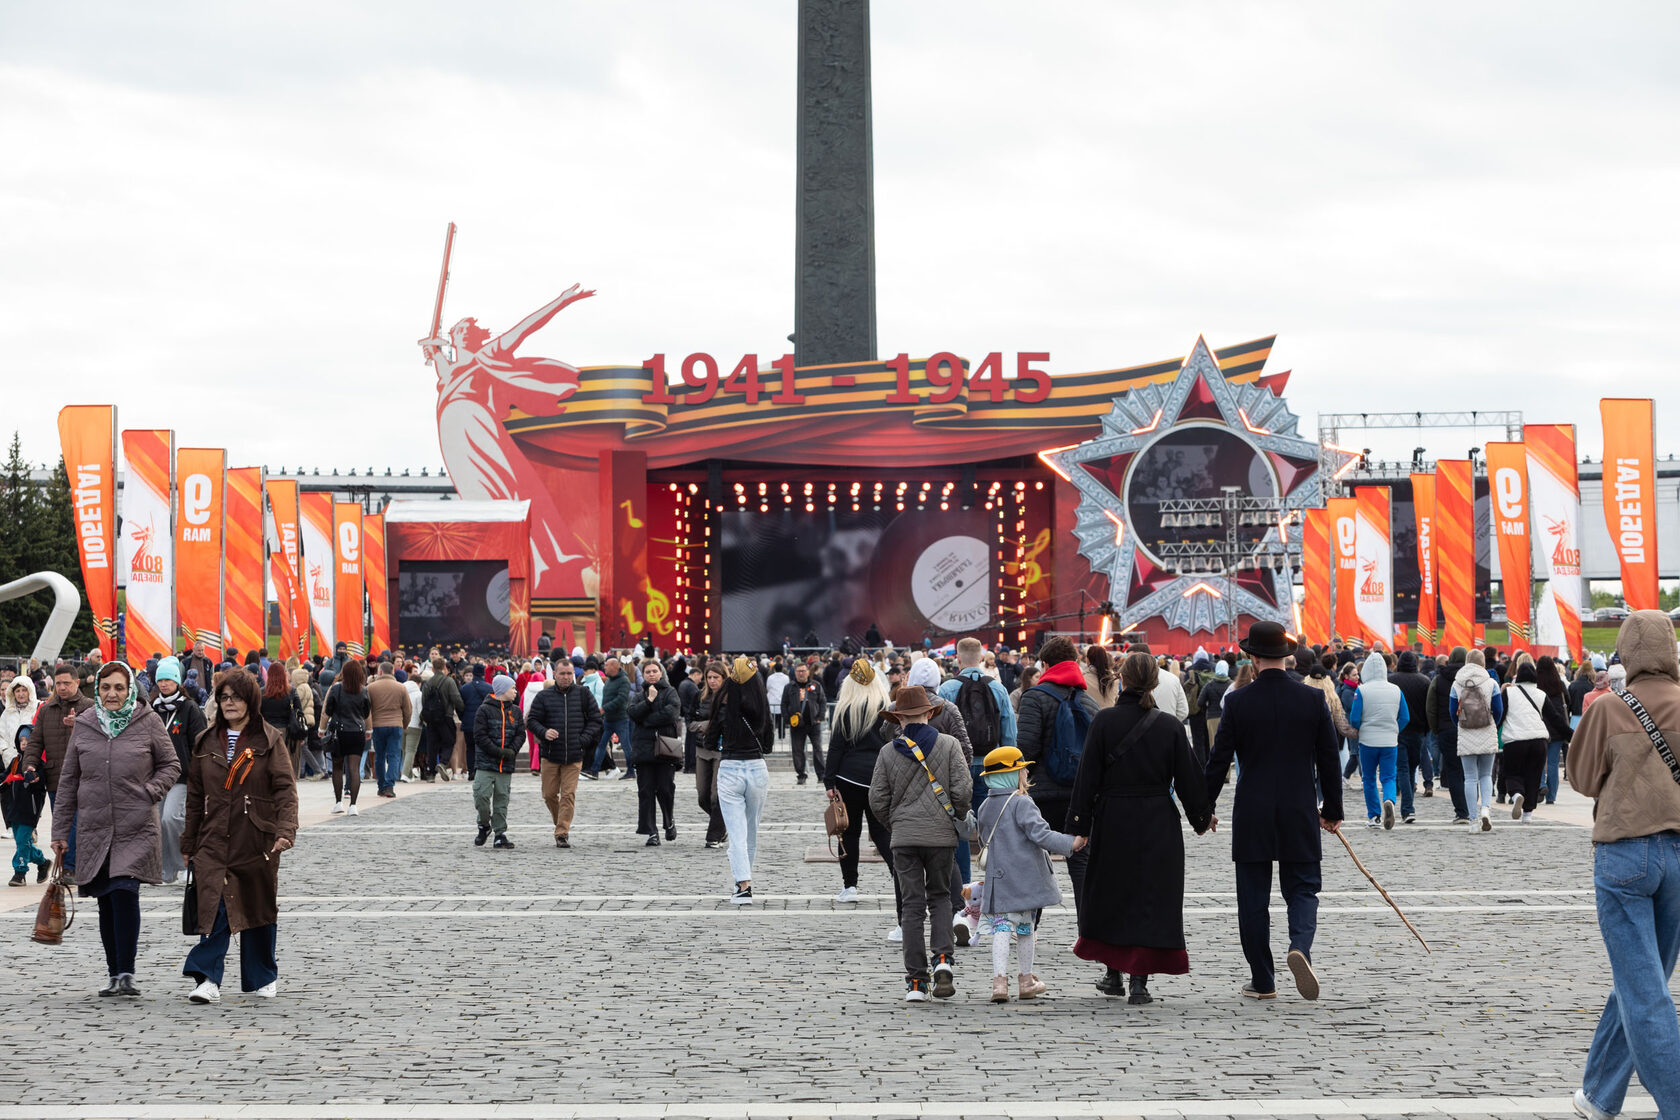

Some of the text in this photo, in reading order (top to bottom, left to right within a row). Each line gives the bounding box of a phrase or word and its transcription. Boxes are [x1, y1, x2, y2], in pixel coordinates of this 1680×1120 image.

[641, 352, 805, 405] 1941
[885, 352, 1053, 404] 1945
[1622, 691, 1656, 732] GETTING
[1650, 730, 1677, 770] BETTER
